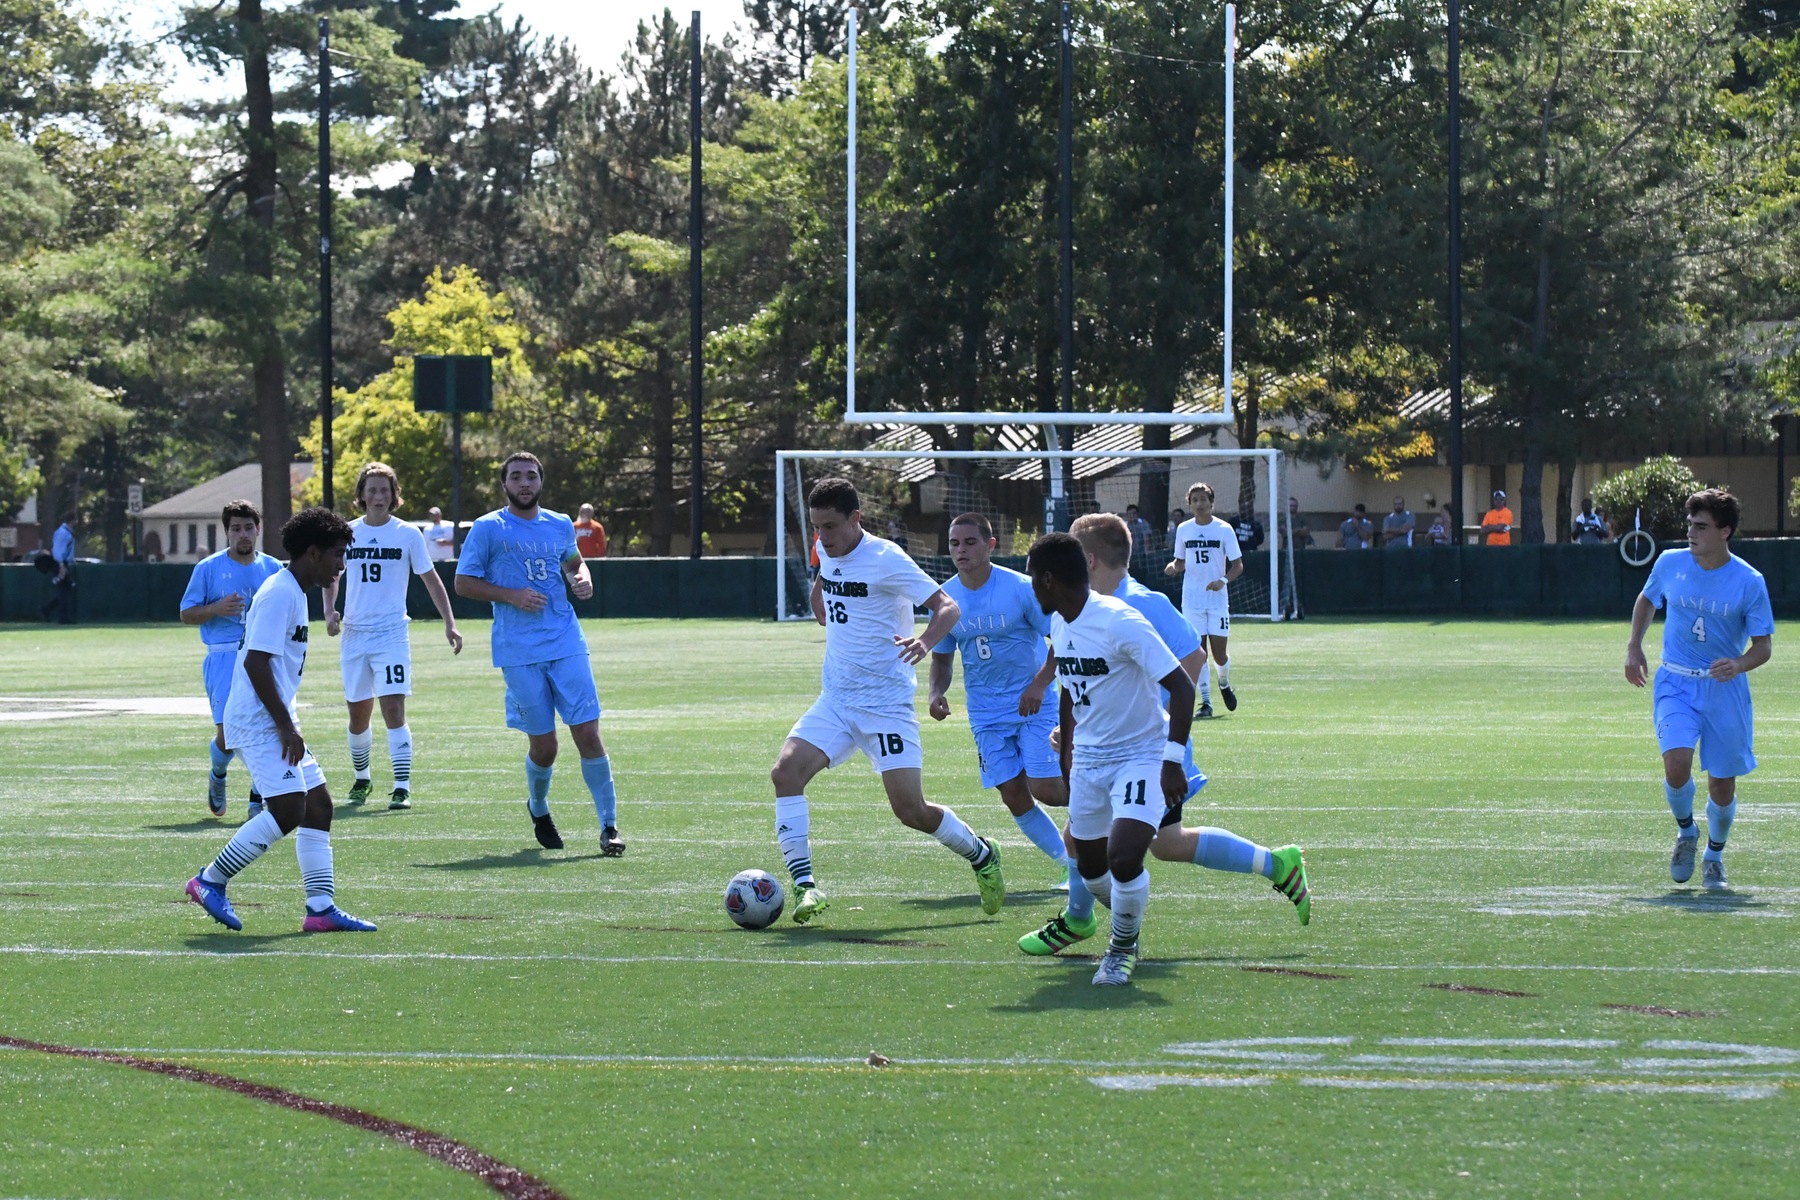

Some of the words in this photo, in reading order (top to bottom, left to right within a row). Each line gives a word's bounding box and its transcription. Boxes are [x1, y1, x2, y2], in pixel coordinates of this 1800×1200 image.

[130, 501, 141, 513] 15
[1195, 550, 1209, 564] 15
[361, 563, 382, 583] 19
[524, 557, 549, 581] 13
[820, 576, 868, 598] USTANGS
[826, 600, 849, 624] 16
[955, 613, 1008, 634] ASELL
[1691, 615, 1707, 643] 4
[975, 634, 993, 661] 6
[386, 664, 405, 685] 19
[877, 732, 905, 758] 16
[1122, 778, 1147, 806] 11
